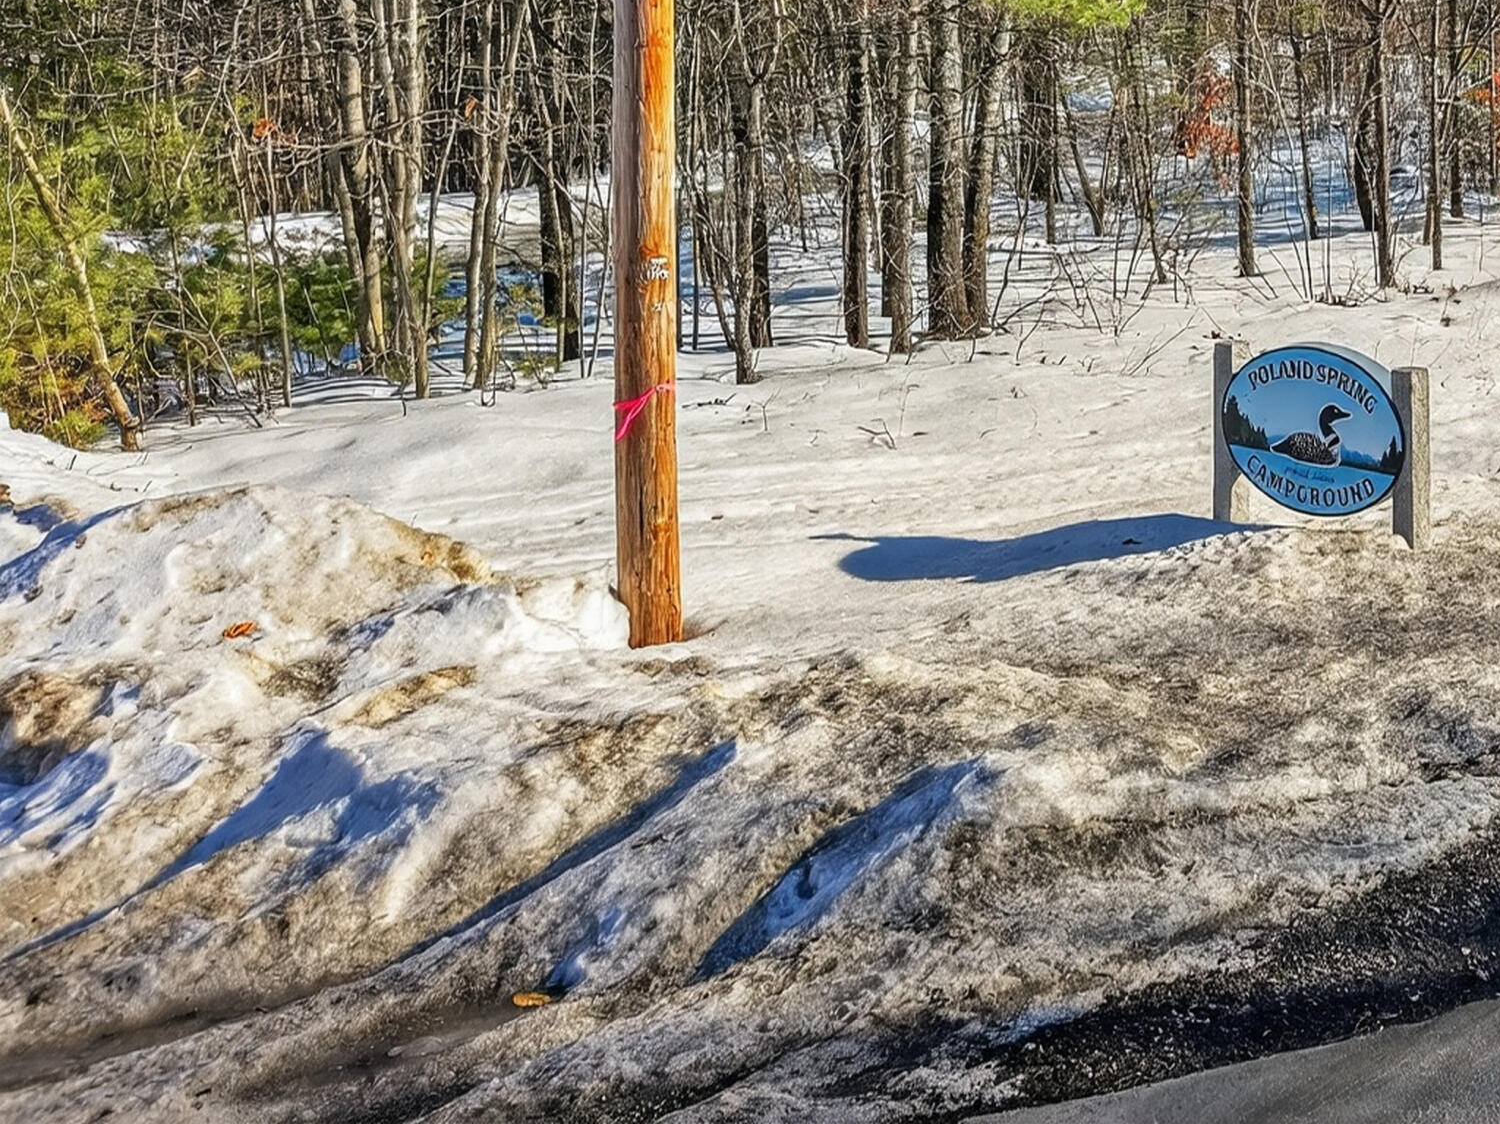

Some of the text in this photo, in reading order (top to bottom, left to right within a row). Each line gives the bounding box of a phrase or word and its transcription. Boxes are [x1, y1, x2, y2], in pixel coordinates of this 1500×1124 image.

[1248, 360, 1378, 414] POLAND SPRING
[1247, 455, 1375, 507] CAMPGROUND
